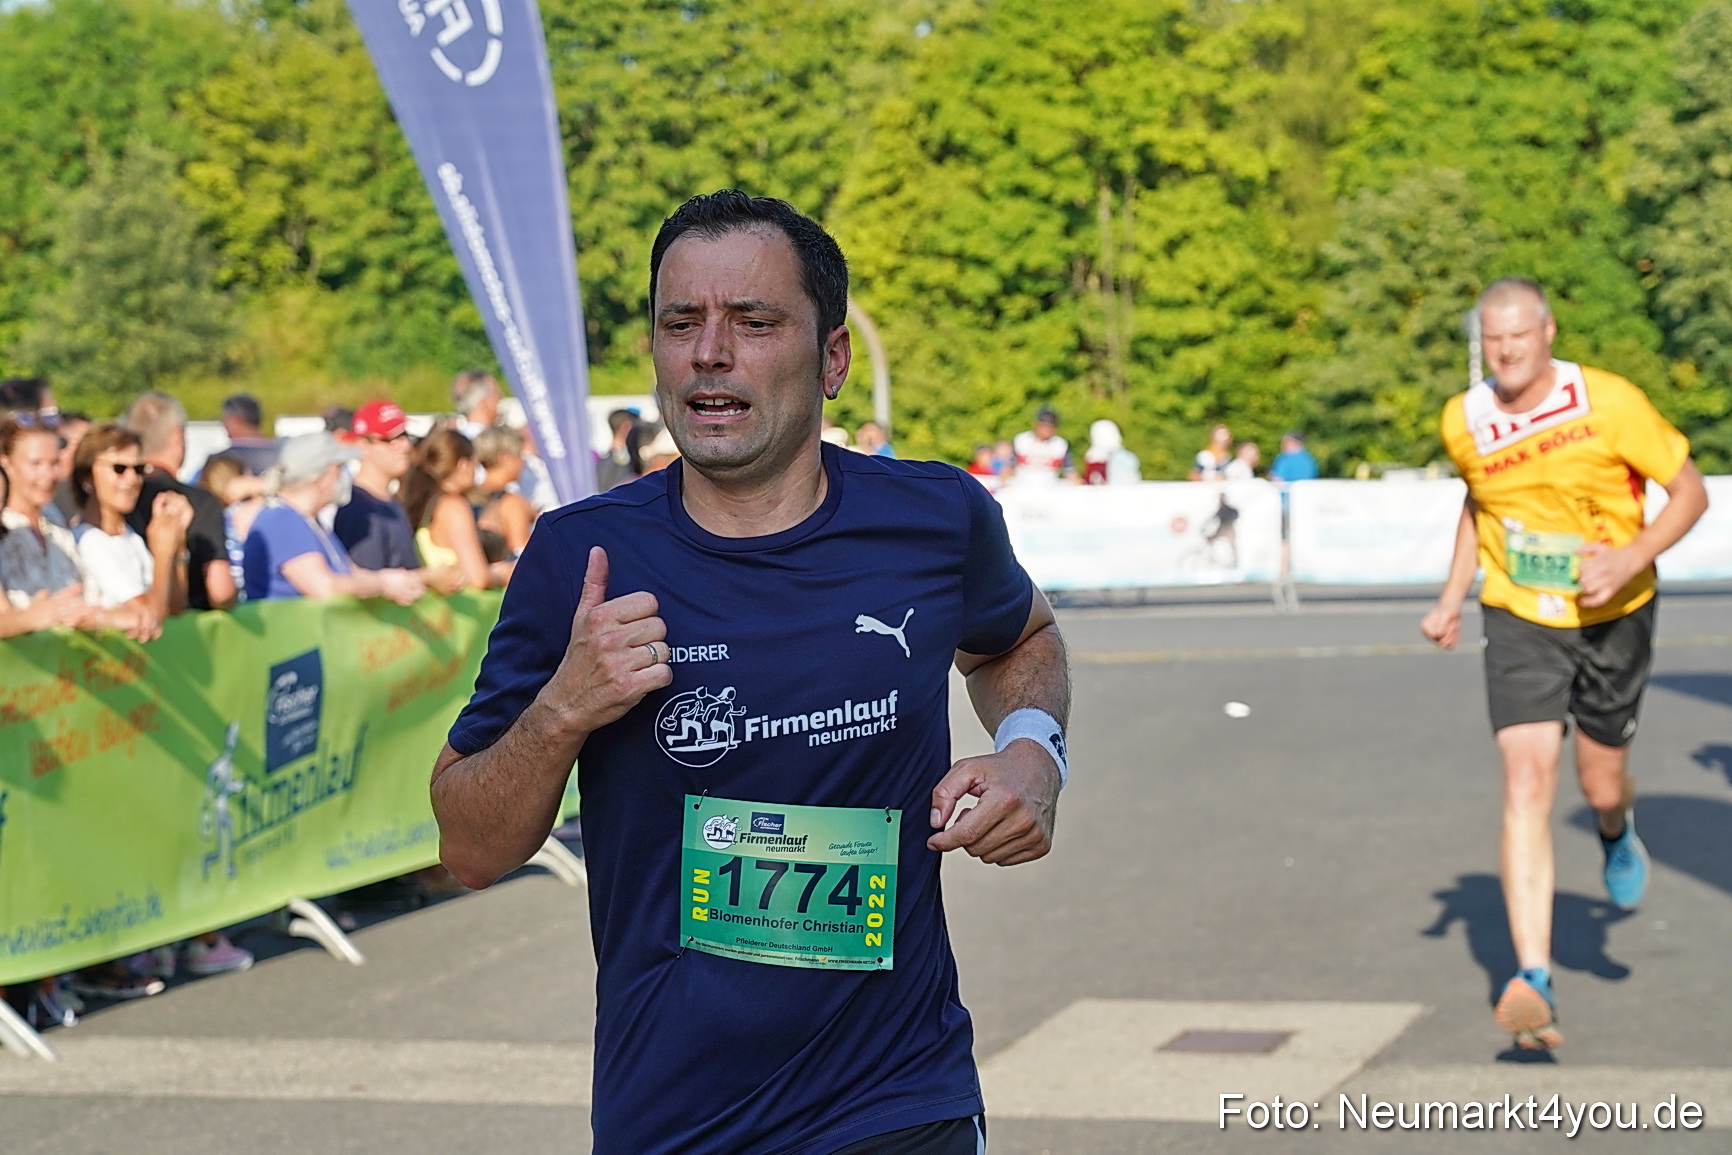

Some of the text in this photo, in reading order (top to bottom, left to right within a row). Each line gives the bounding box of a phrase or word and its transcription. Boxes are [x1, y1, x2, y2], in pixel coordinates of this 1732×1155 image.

[745, 689, 898, 742] Firmenlauf
[808, 715, 898, 747] neumarkt
[739, 832, 808, 845] Firmenlauf
[765, 845, 806, 853] neumarkt
[692, 868, 711, 922] RUN
[719, 856, 863, 916] 1774
[709, 908, 864, 934] Blomenhofer Christian
[865, 874, 886, 947] 2022
[735, 937, 833, 953] Pfleiderer Deutschland GmbH
